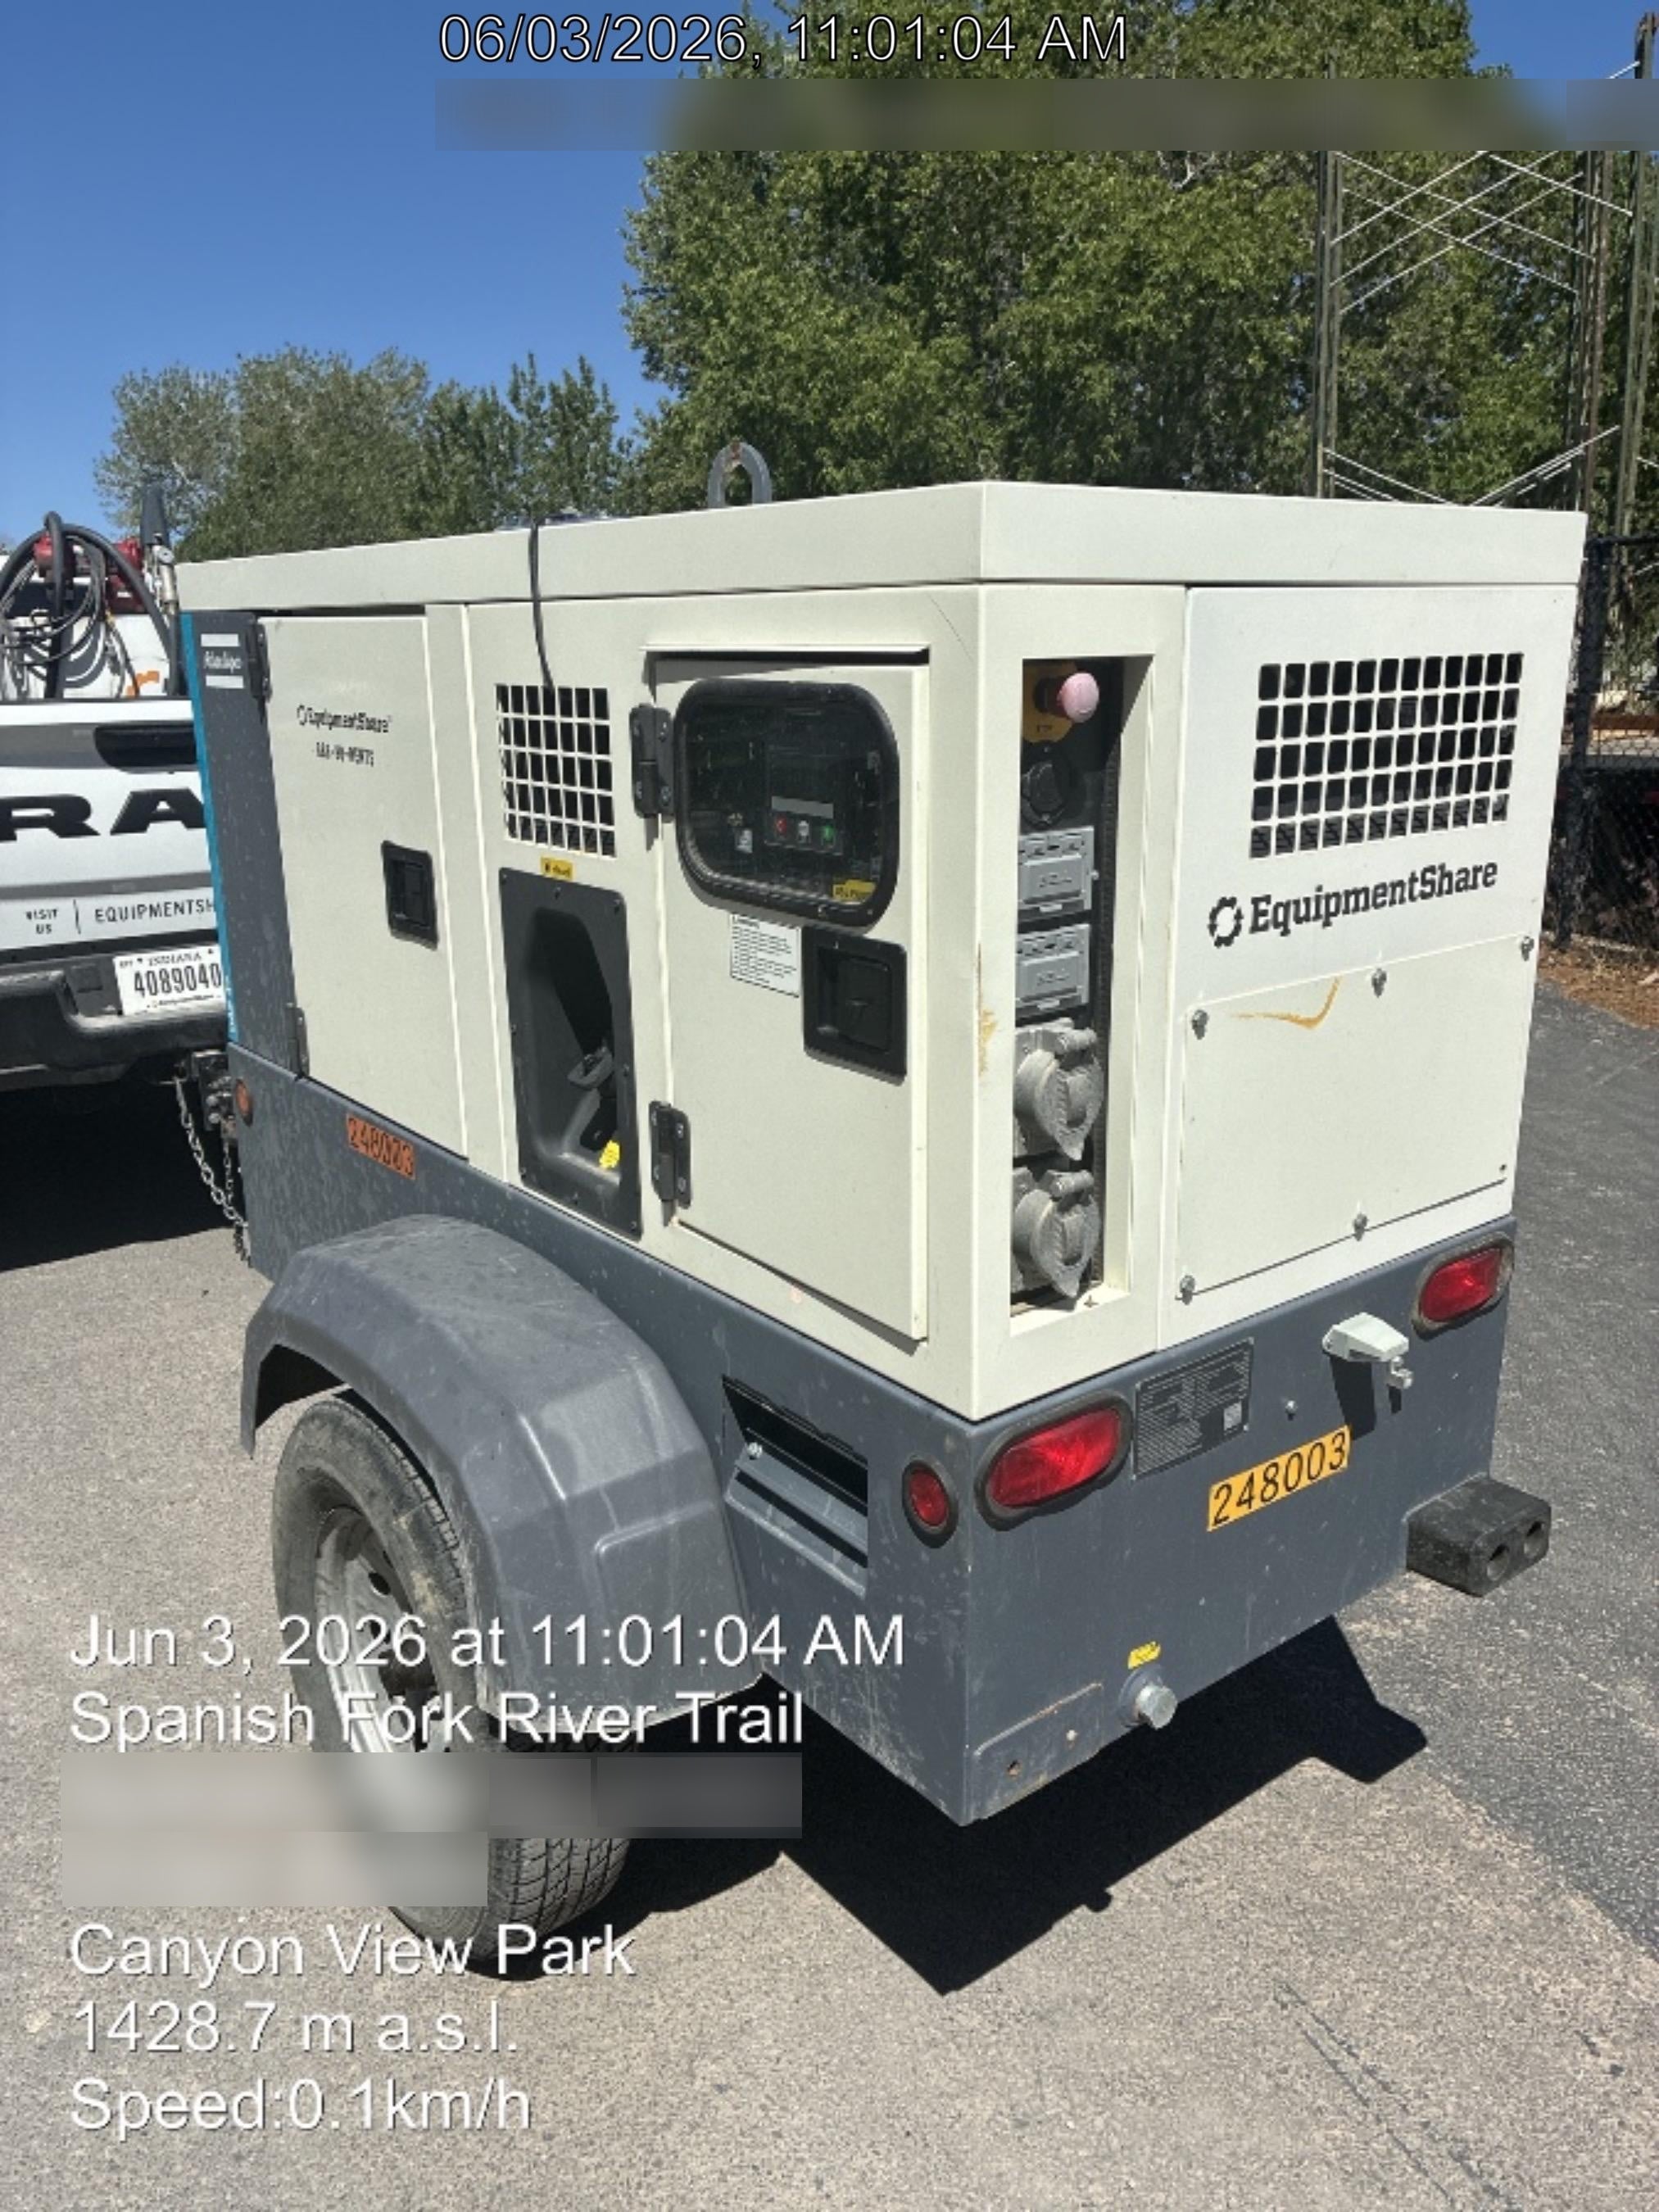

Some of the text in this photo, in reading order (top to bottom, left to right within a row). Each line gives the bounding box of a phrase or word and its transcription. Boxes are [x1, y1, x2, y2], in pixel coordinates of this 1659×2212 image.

[36, 924, 52, 935] US
[1249, 862, 1498, 936] EquipmentShare
[1213, 1432, 1345, 1525] 248003
